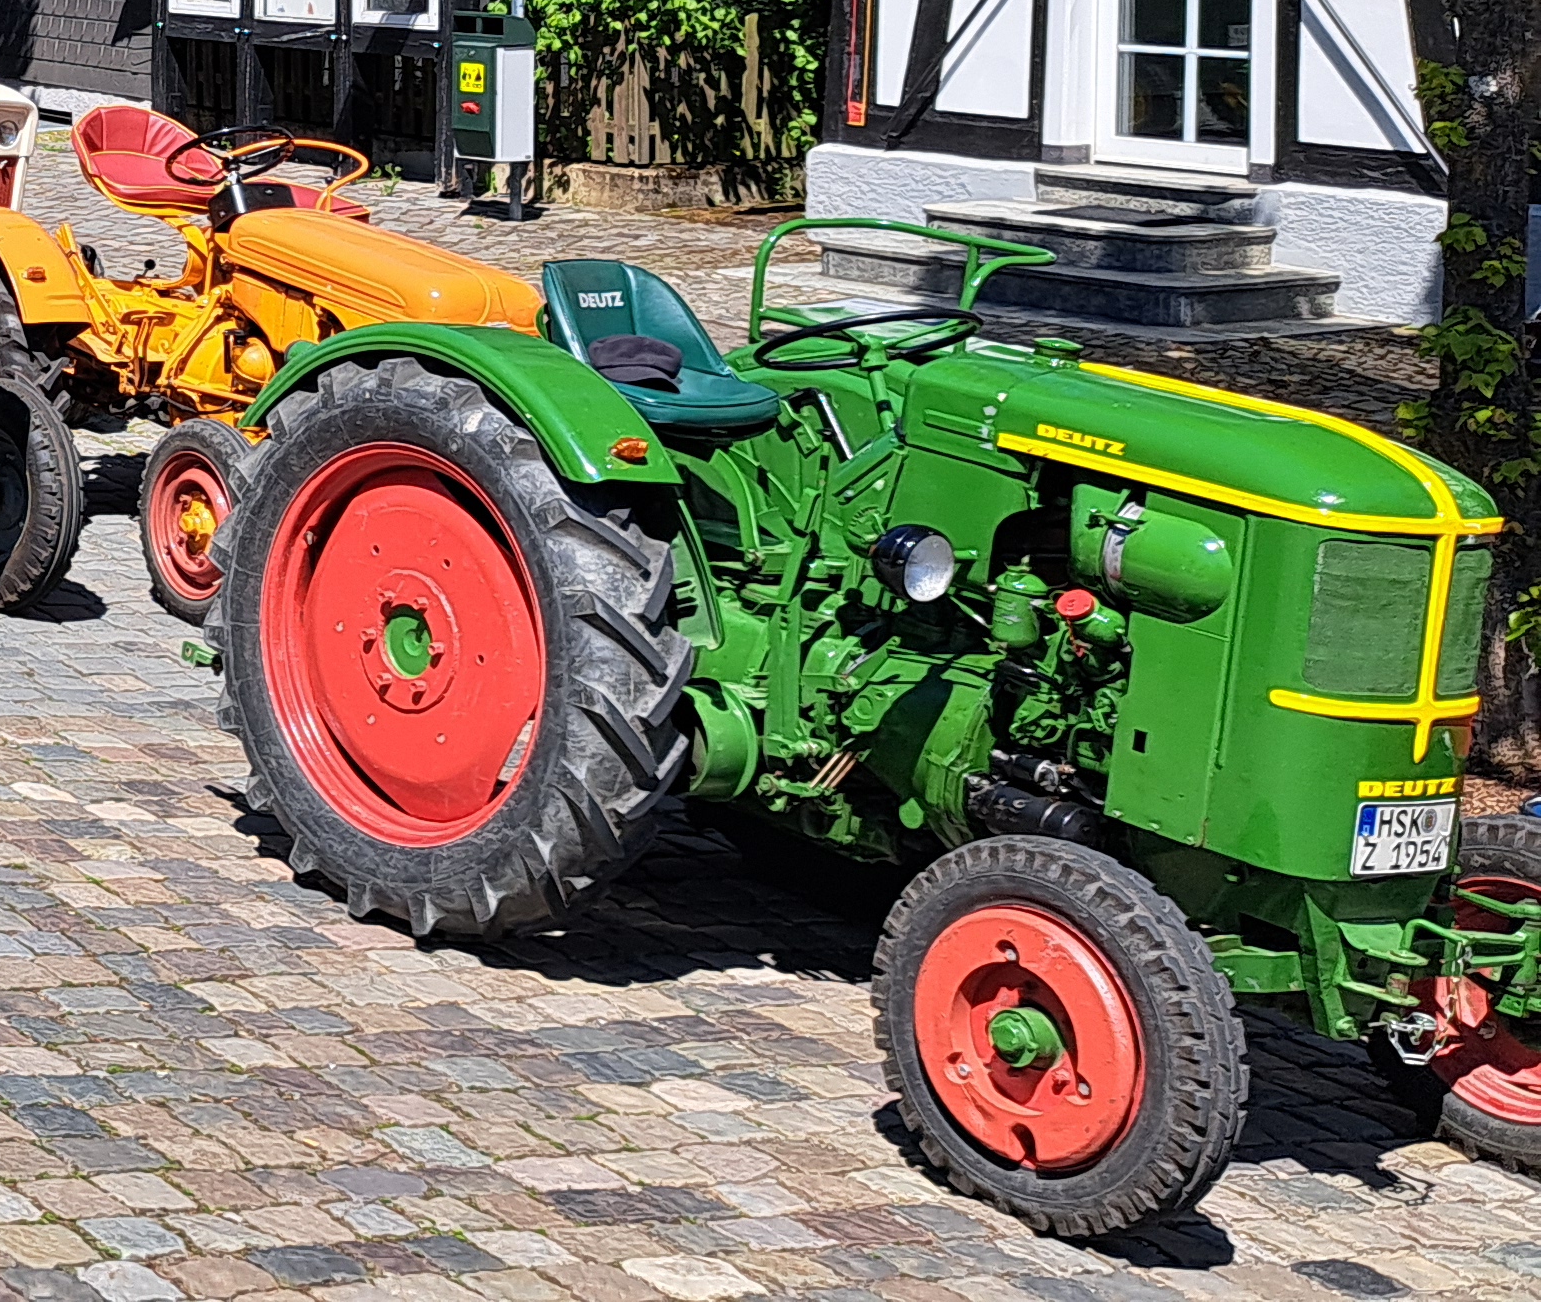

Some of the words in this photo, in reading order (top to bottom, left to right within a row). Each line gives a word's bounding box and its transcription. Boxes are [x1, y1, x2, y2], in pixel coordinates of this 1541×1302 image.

[577, 291, 624, 308] DEUTZ
[1037, 423, 1126, 456] DEUTZ
[1358, 778, 1456, 798] DEUTZ
[1377, 808, 1424, 838] HSK
[1360, 842, 1378, 871] Z
[1388, 837, 1449, 870] 1954
